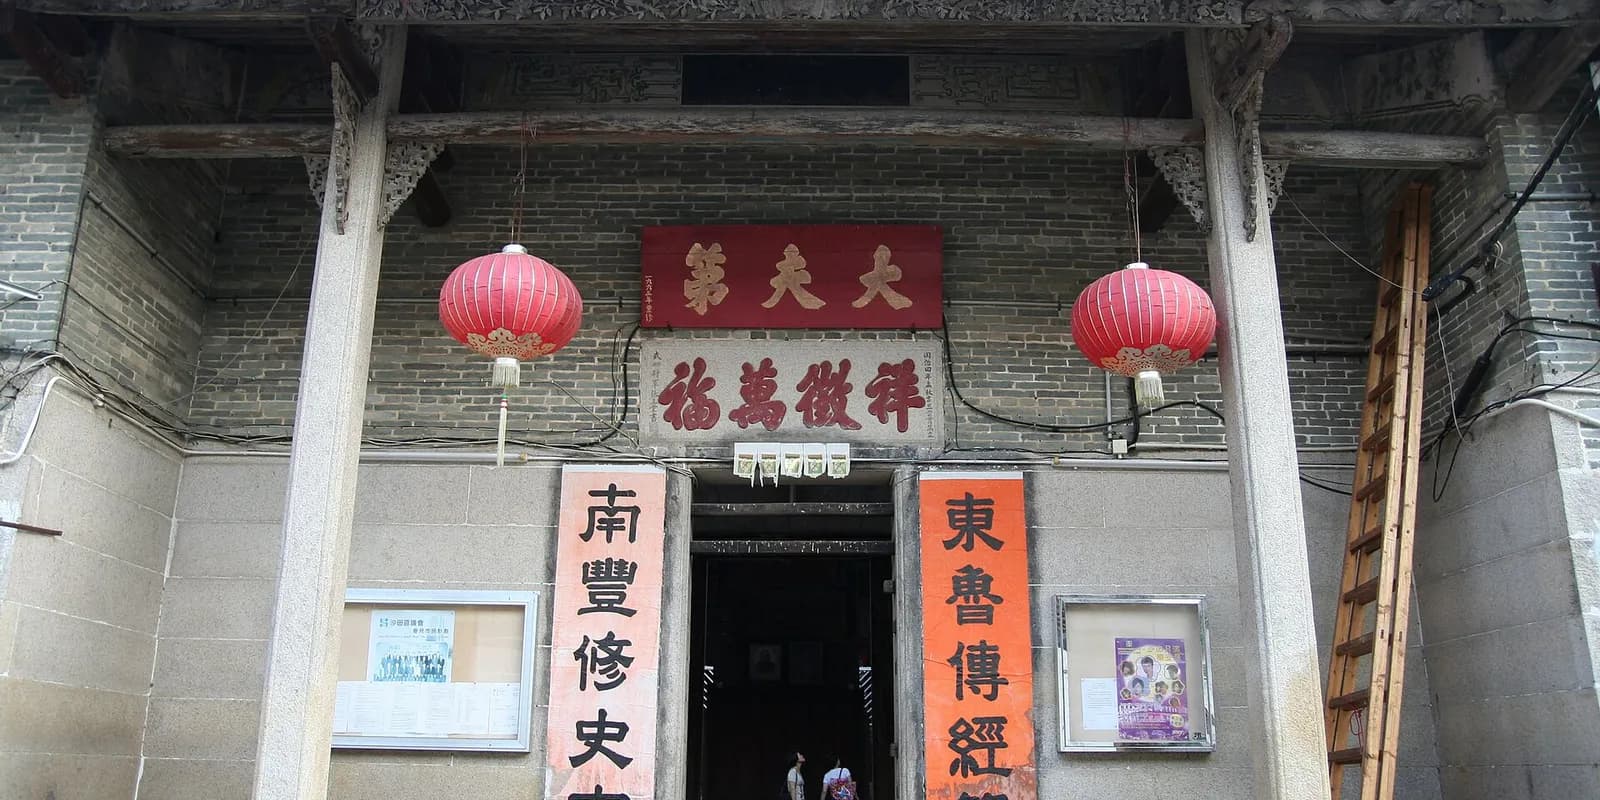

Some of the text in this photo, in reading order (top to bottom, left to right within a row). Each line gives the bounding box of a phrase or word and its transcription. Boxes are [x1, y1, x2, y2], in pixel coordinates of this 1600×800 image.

[567, 483, 641, 800] 南豐修史
[942, 492, 1012, 800] 東魯傳經
